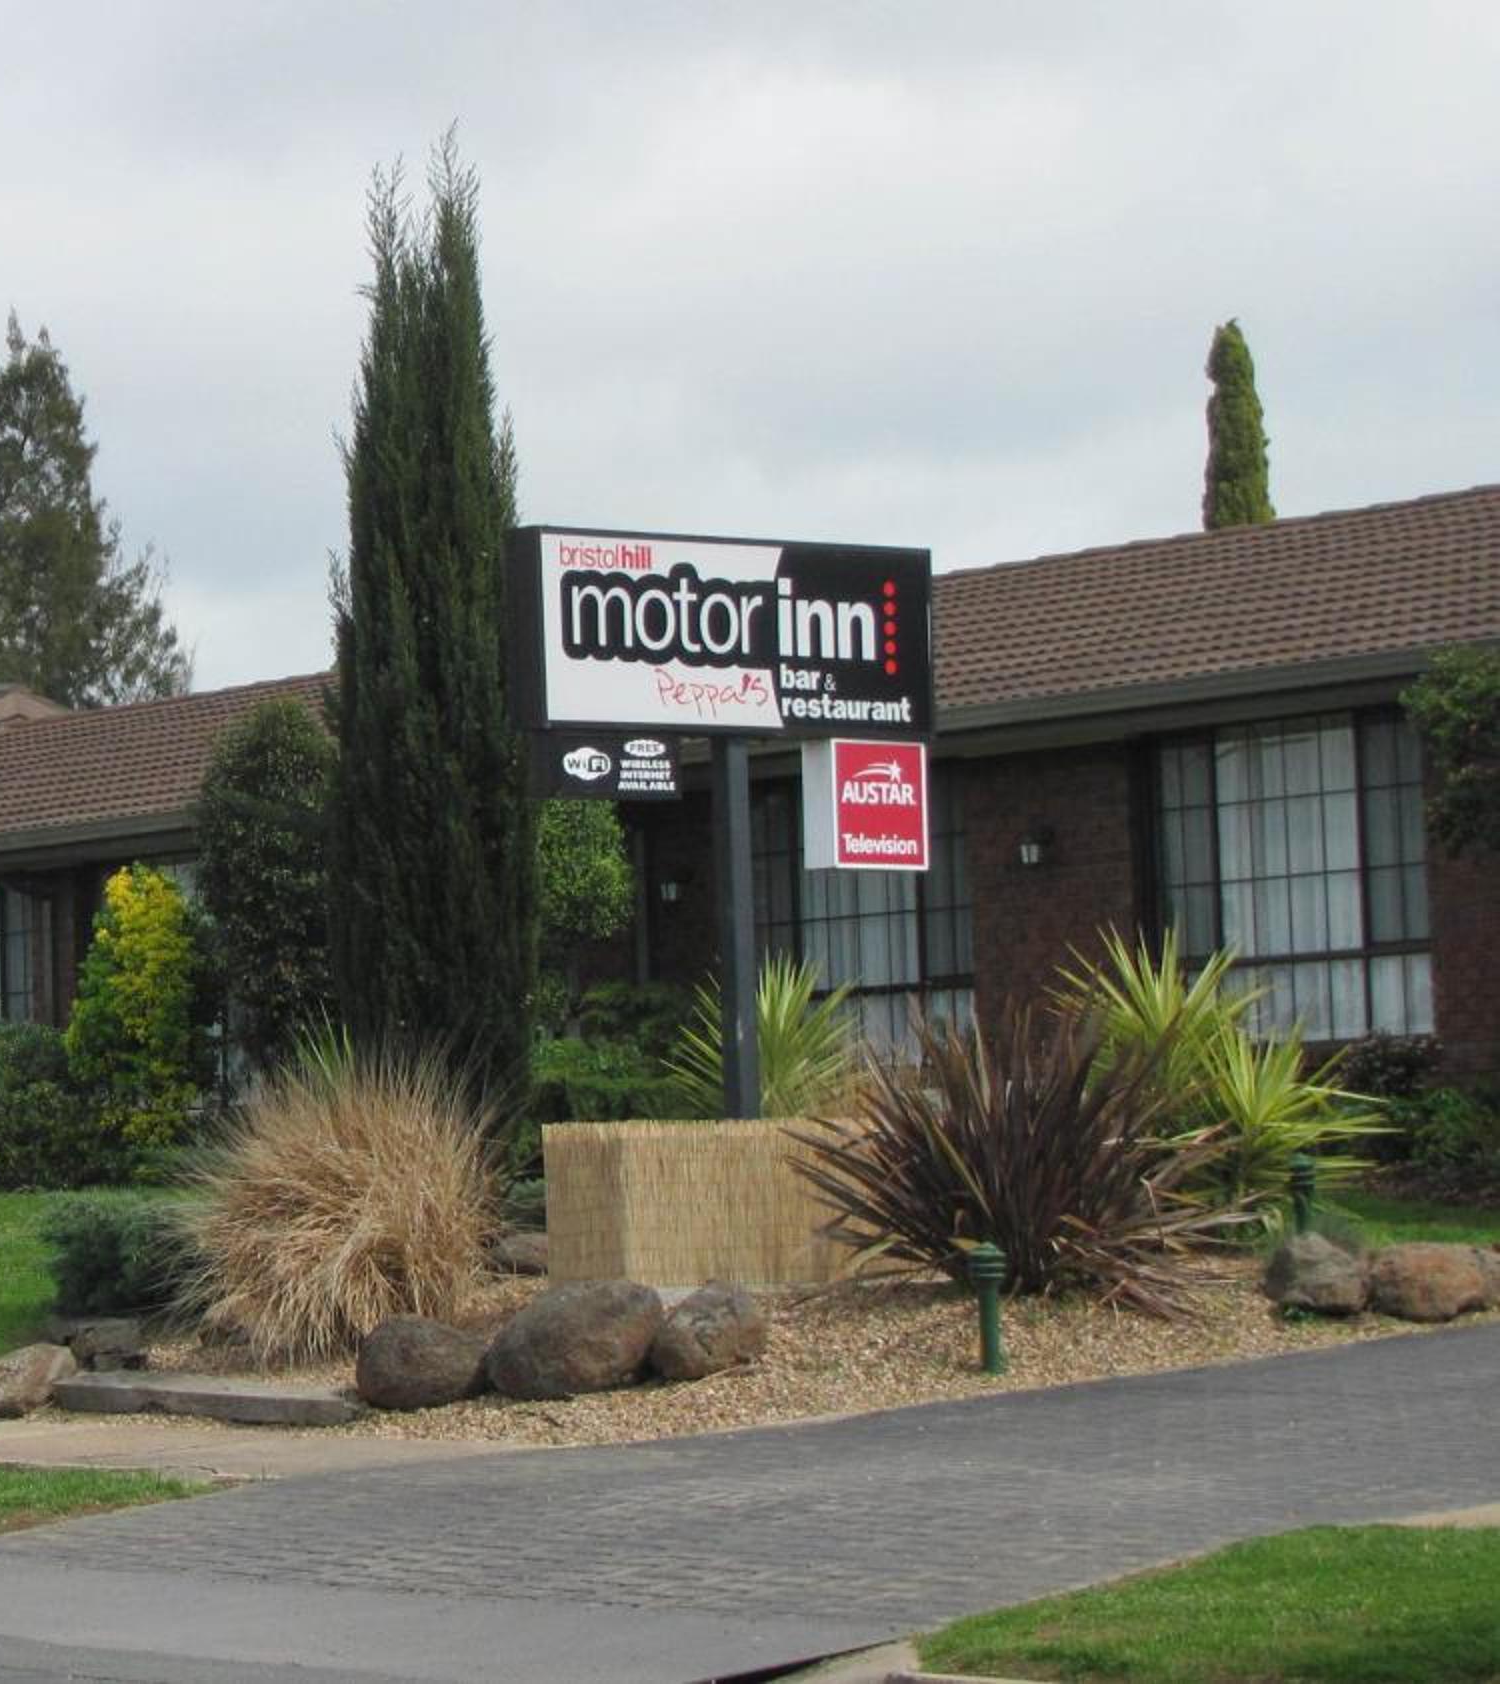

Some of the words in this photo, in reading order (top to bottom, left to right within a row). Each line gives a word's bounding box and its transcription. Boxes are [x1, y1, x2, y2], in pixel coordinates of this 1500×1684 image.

[559, 541, 653, 570] bristolhill
[571, 577, 764, 656] motor
[777, 577, 877, 661] inn
[780, 663, 821, 691] bar
[823, 673, 836, 692] &
[654, 667, 770, 718] Peppa's
[781, 693, 912, 723] restaurant
[629, 742, 662, 753] FREE
[619, 759, 671, 769] WIRELESS
[619, 769, 671, 780] INTERNET
[617, 780, 676, 791] AVAILABLE
[841, 780, 916, 806] AUSTAR
[841, 832, 918, 856] Television
